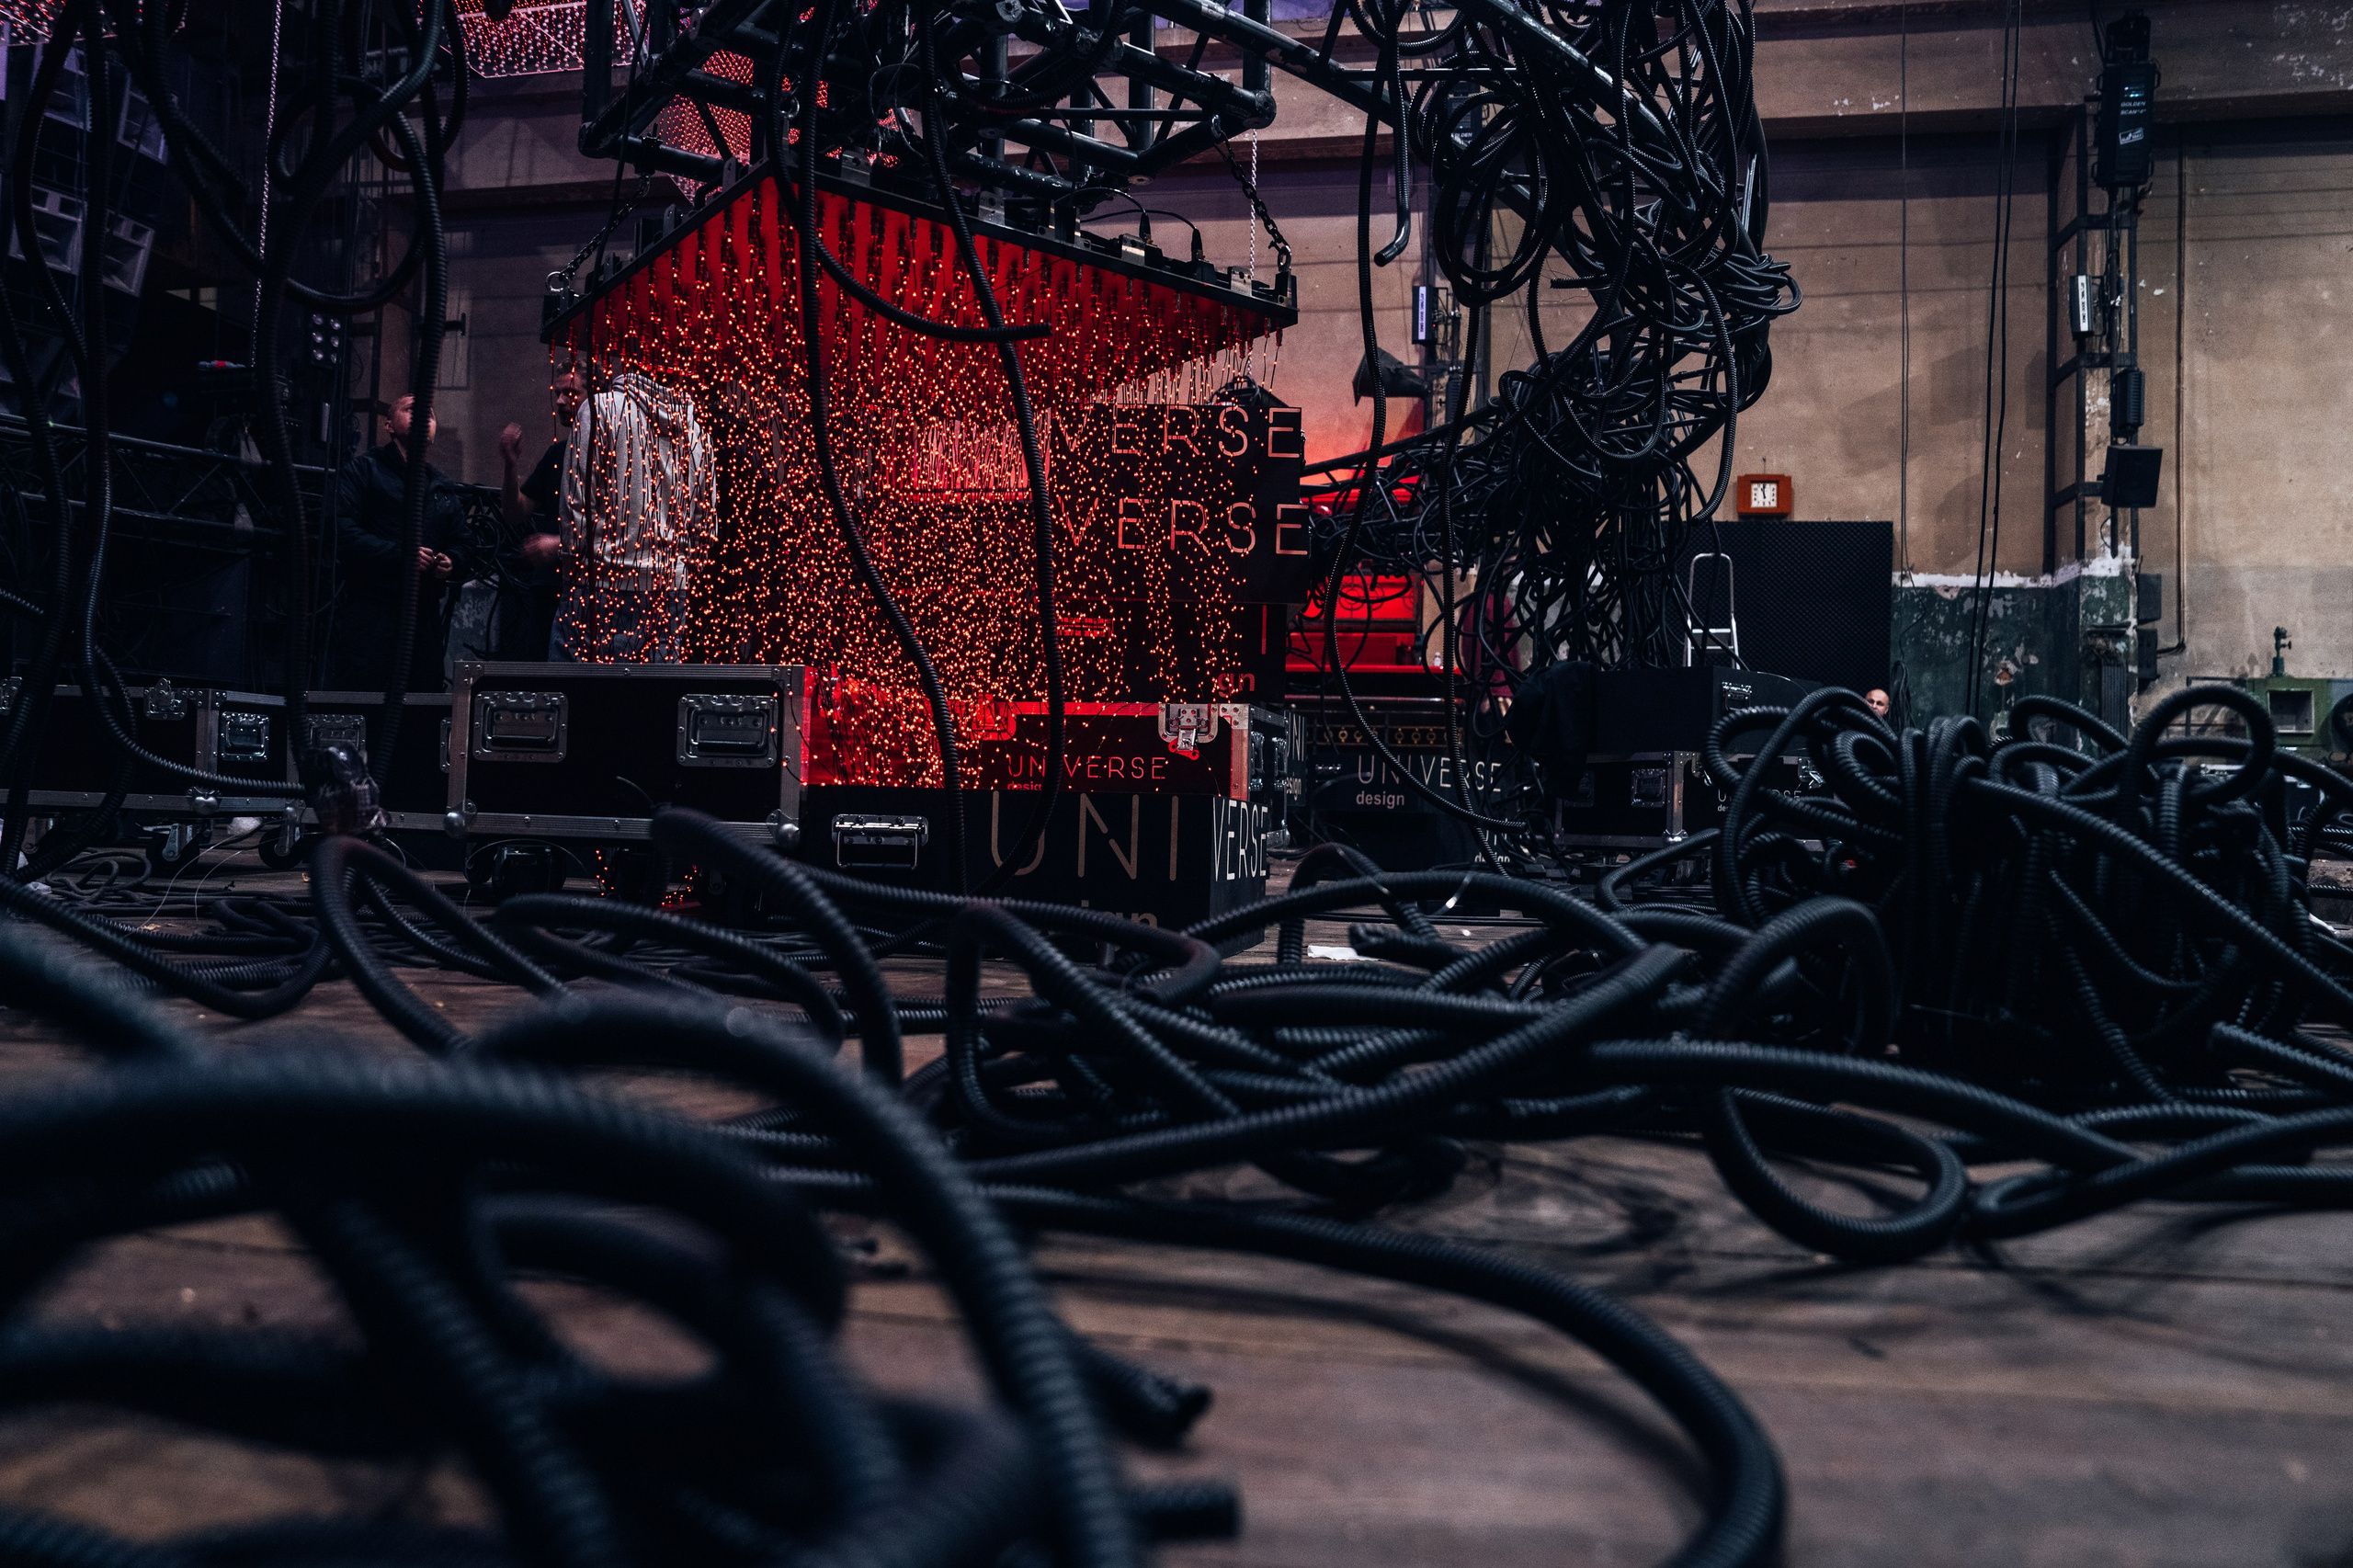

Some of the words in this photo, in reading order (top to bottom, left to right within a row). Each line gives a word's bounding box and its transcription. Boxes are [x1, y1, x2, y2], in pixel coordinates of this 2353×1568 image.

[1057, 404, 1302, 459] VERSE
[1058, 496, 1310, 555] VERSE
[1007, 756, 1166, 779] UNVERSE
[1286, 771, 1302, 801] esign
[1356, 790, 1405, 810] design
[991, 790, 1179, 881] UNI
[1212, 795, 1268, 882] VERSE
